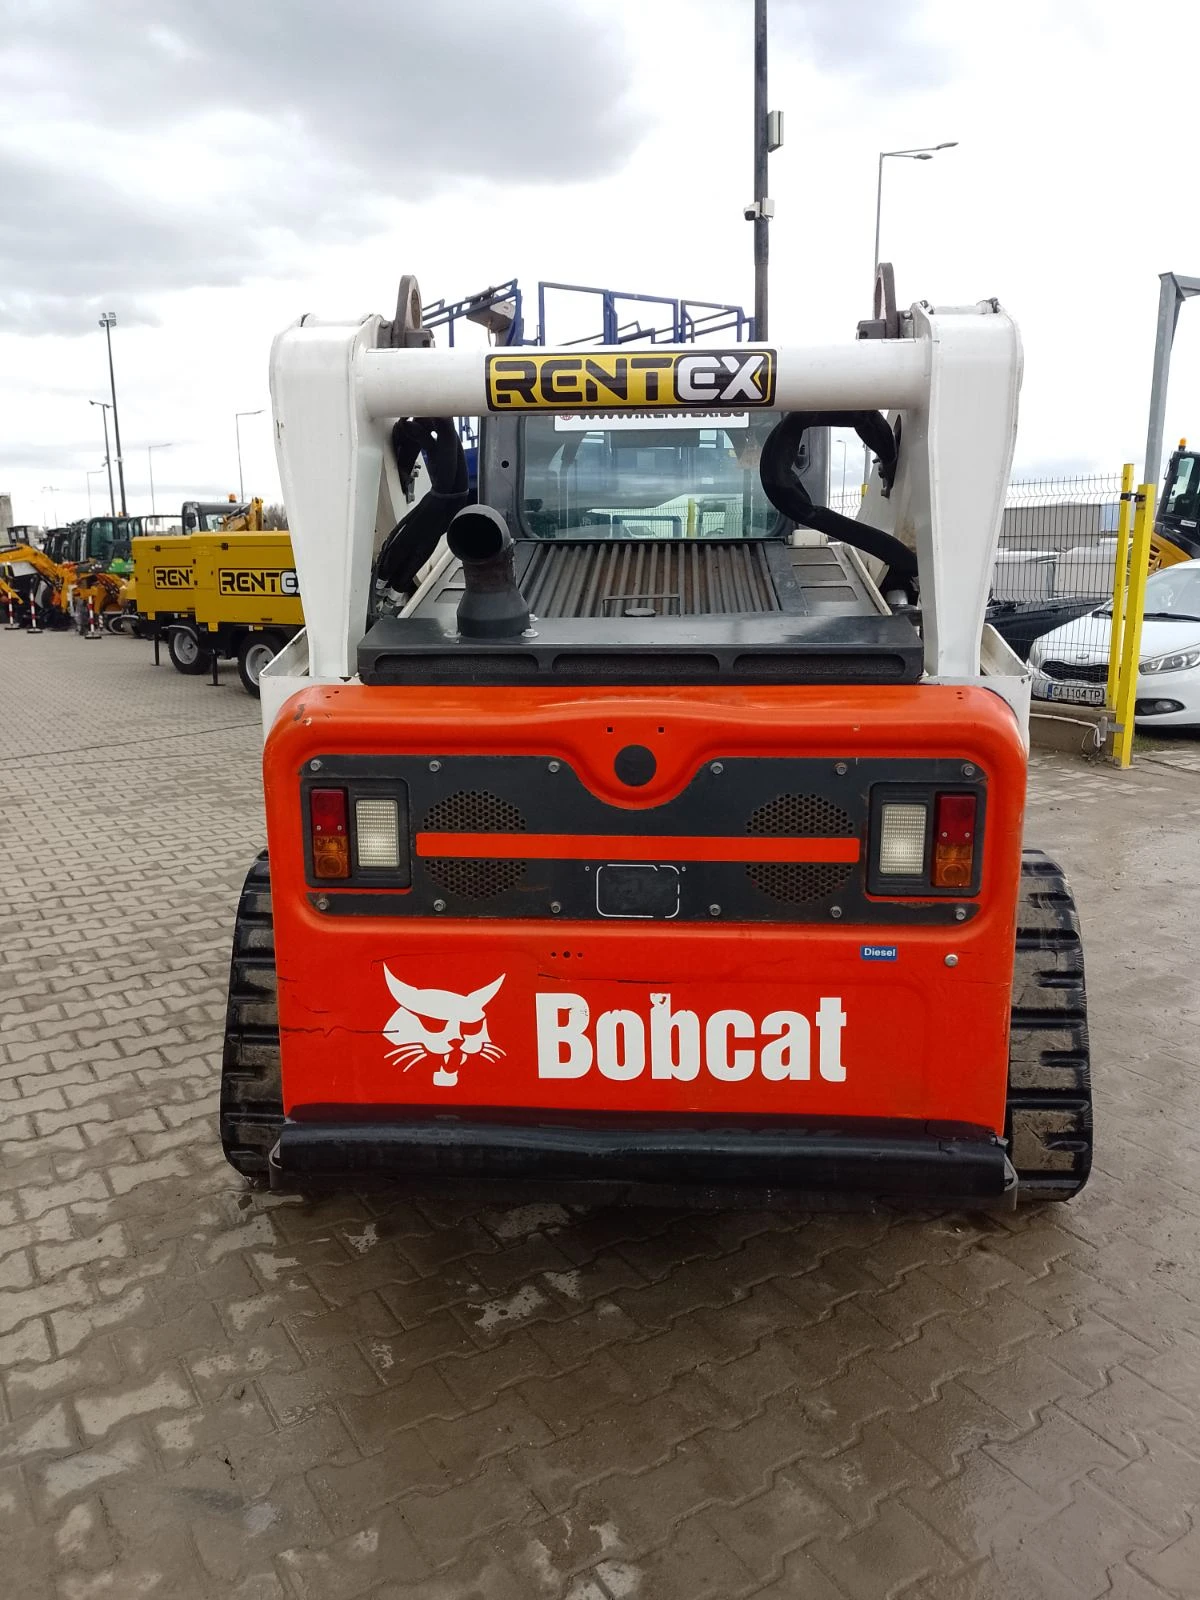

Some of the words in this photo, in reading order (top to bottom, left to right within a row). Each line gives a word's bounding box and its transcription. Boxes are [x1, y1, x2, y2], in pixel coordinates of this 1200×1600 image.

[494, 355, 765, 404] RENTEX
[155, 569, 194, 587] REN
[1088, 689, 1101, 700] TP
[864, 947, 896, 957] Diesel
[535, 992, 847, 1082] Bobcat
